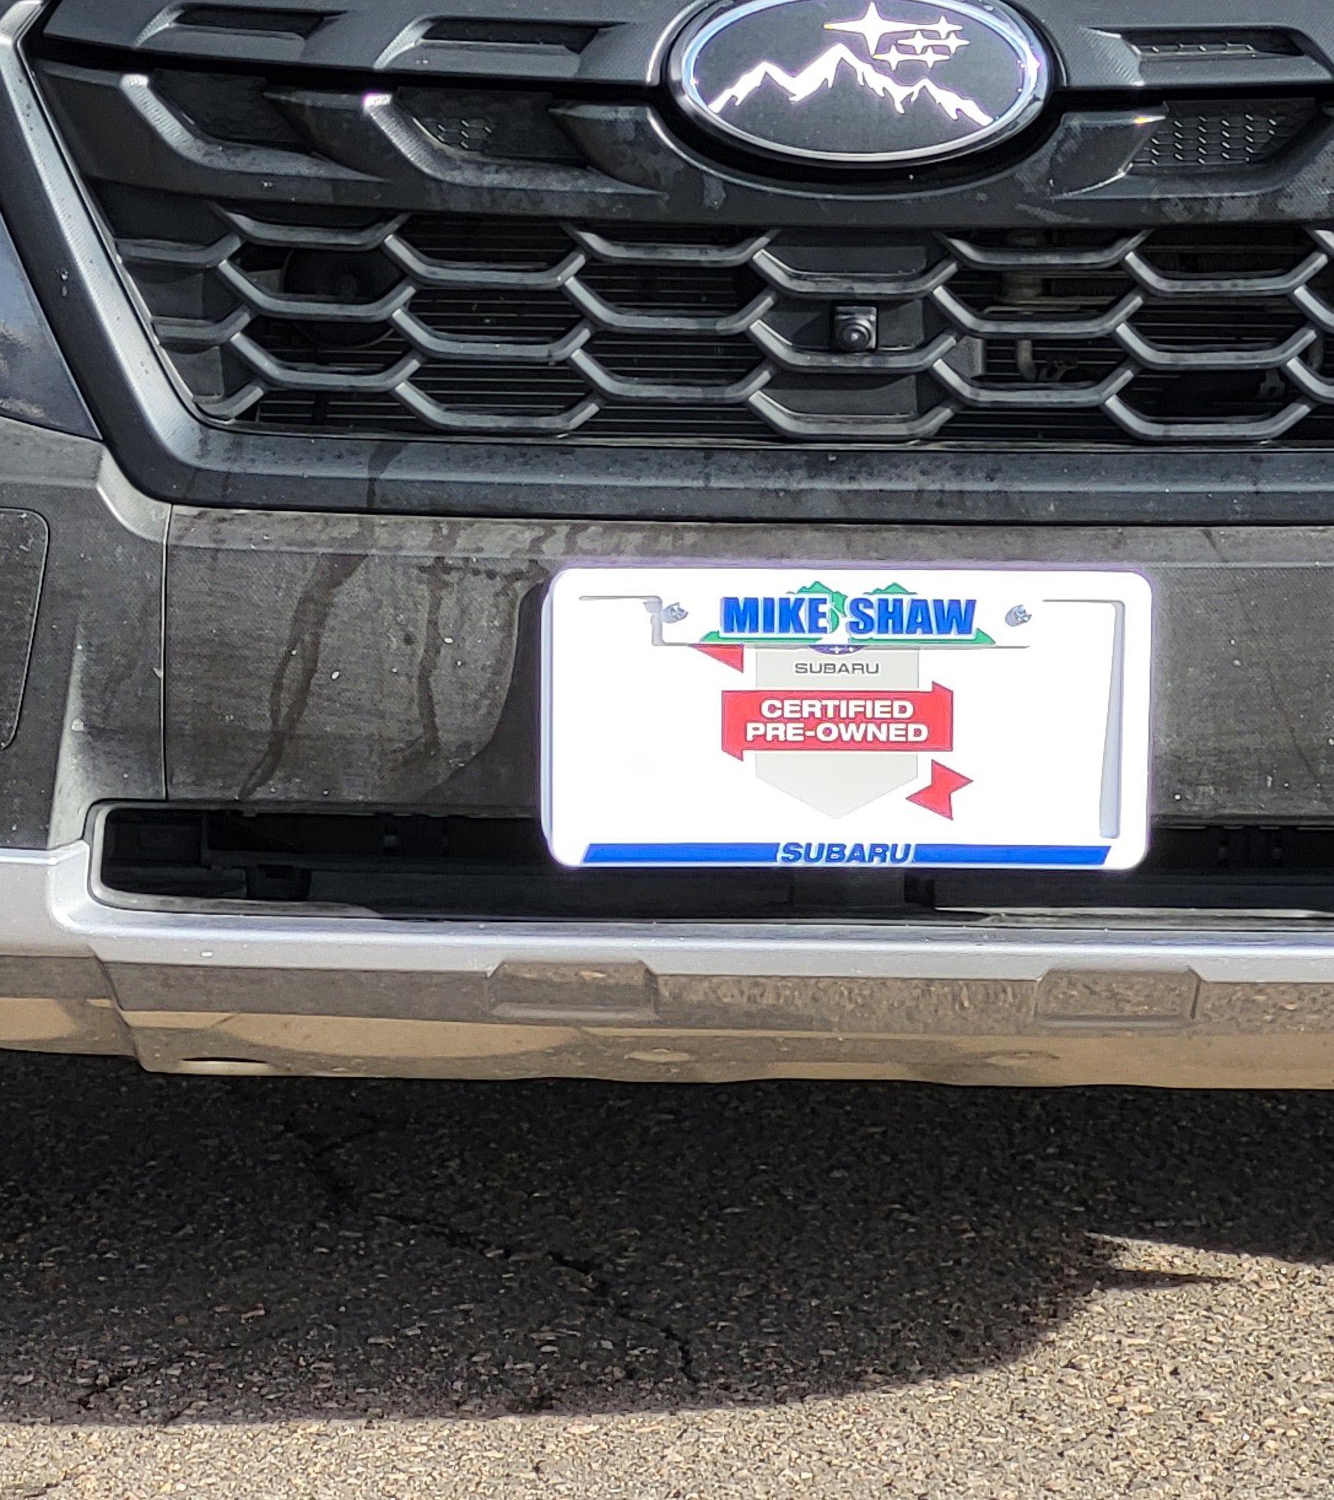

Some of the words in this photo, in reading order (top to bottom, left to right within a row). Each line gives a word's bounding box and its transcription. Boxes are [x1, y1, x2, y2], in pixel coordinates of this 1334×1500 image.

[722, 596, 829, 634] MIKE
[848, 597, 977, 635] SHAW
[794, 663, 880, 674] SUBARU
[760, 700, 915, 719] CERTIFIED
[745, 722, 930, 743] PRE-OWNED
[781, 842, 912, 863] SUBARU
